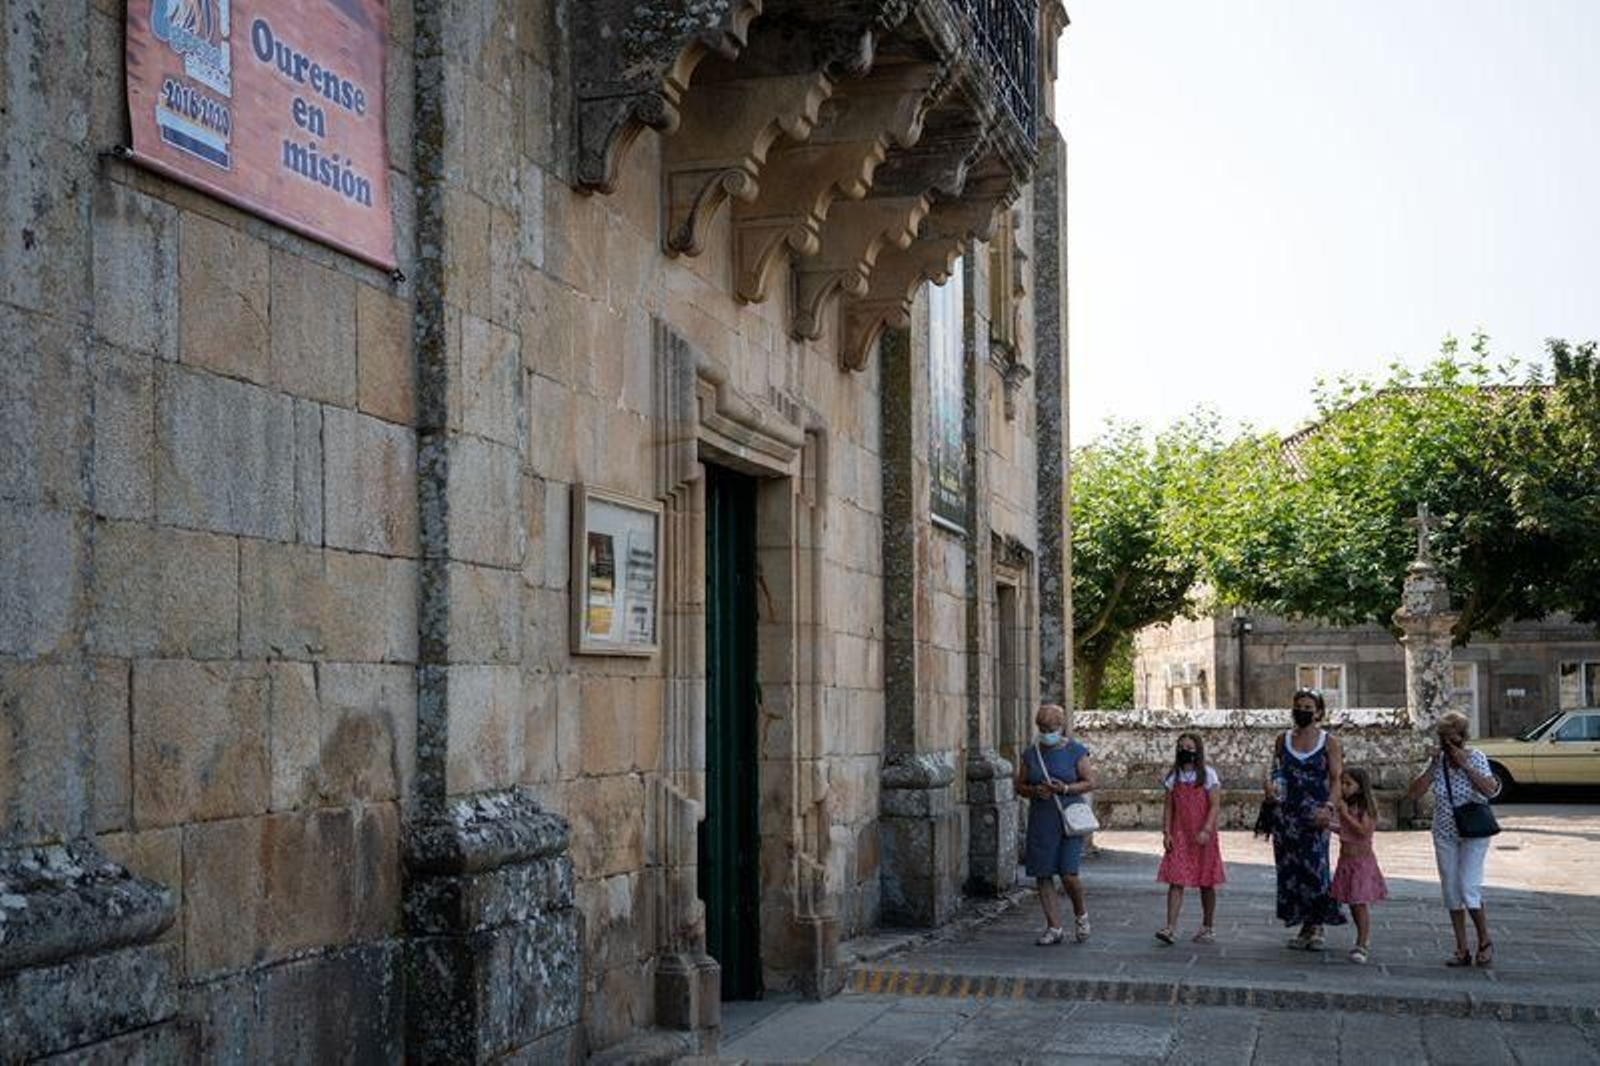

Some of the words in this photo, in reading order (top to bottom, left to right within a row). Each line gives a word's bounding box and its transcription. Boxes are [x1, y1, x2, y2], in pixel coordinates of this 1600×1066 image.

[251, 18, 367, 116] Ourense
[293, 96, 326, 138] en
[283, 139, 373, 208] misión
